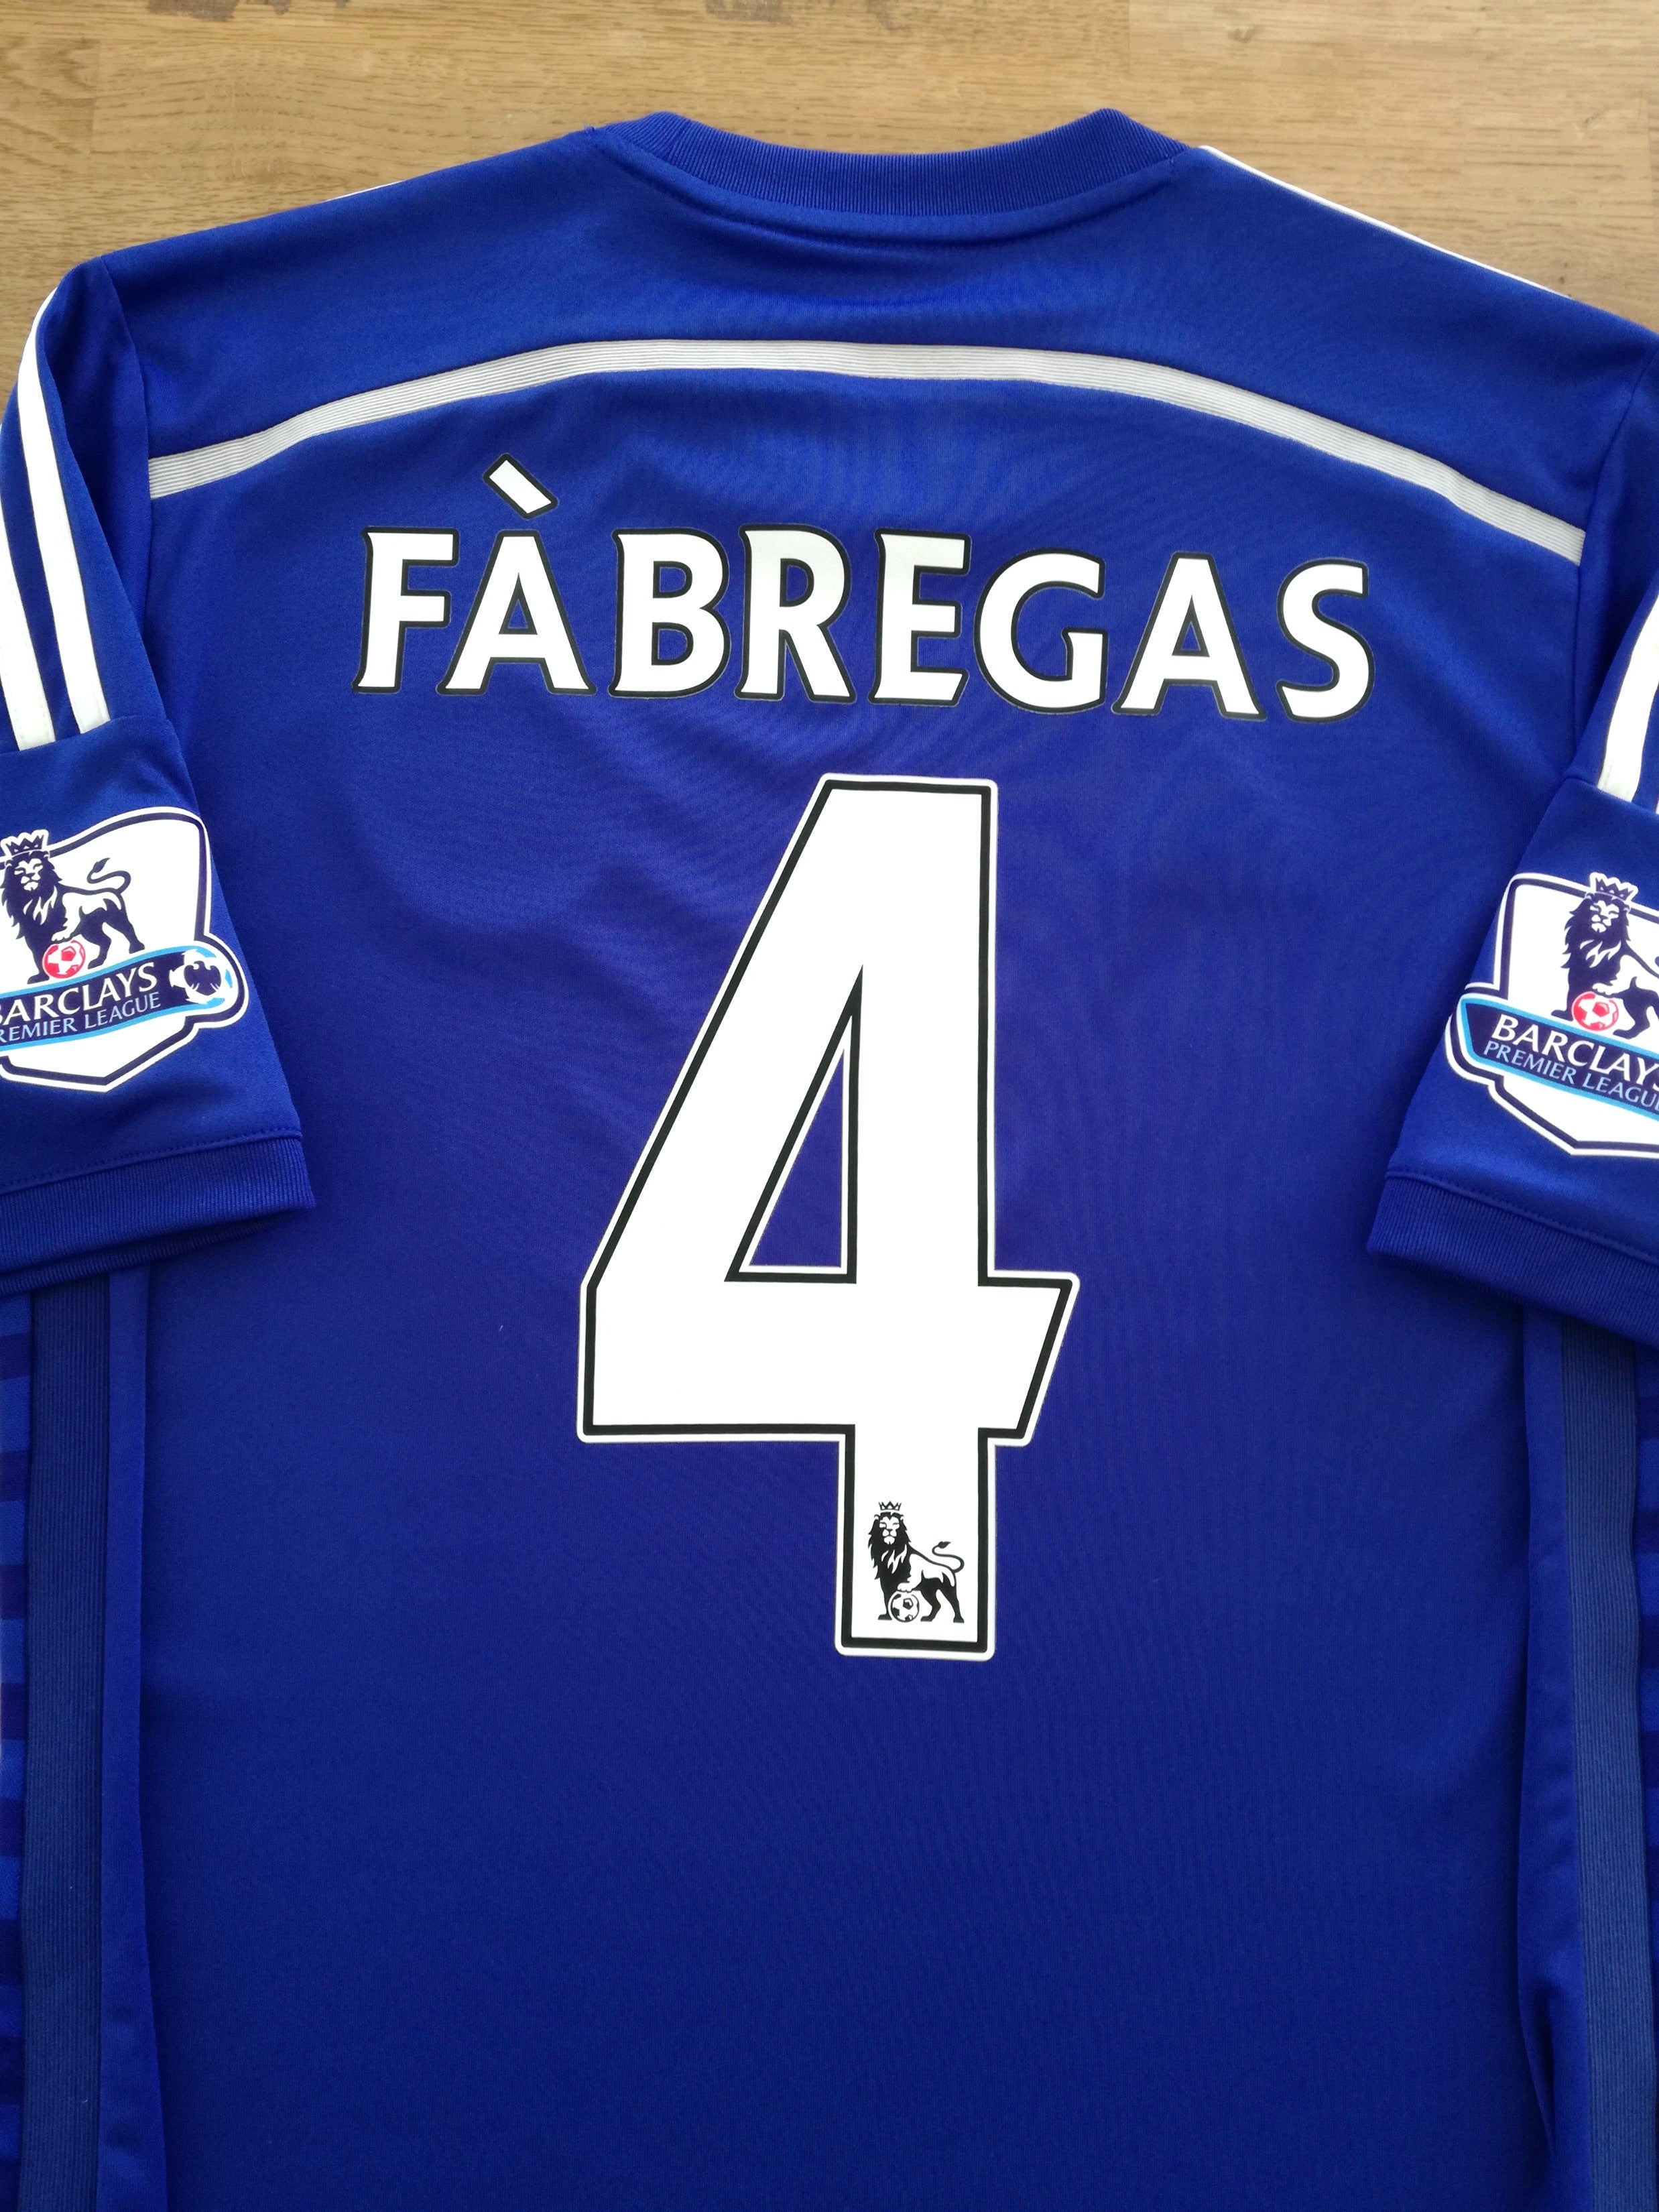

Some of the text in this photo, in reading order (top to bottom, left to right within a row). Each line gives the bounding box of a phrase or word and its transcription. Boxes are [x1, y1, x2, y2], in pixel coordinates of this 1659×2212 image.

[352, 454, 1375, 721] FÀBREGAS
[0, 962, 158, 1026] ARCLAYS
[84, 991, 161, 1030] LEAGUE
[1483, 1040, 1575, 1085] PREMIER
[578, 773, 1080, 1660] 4
